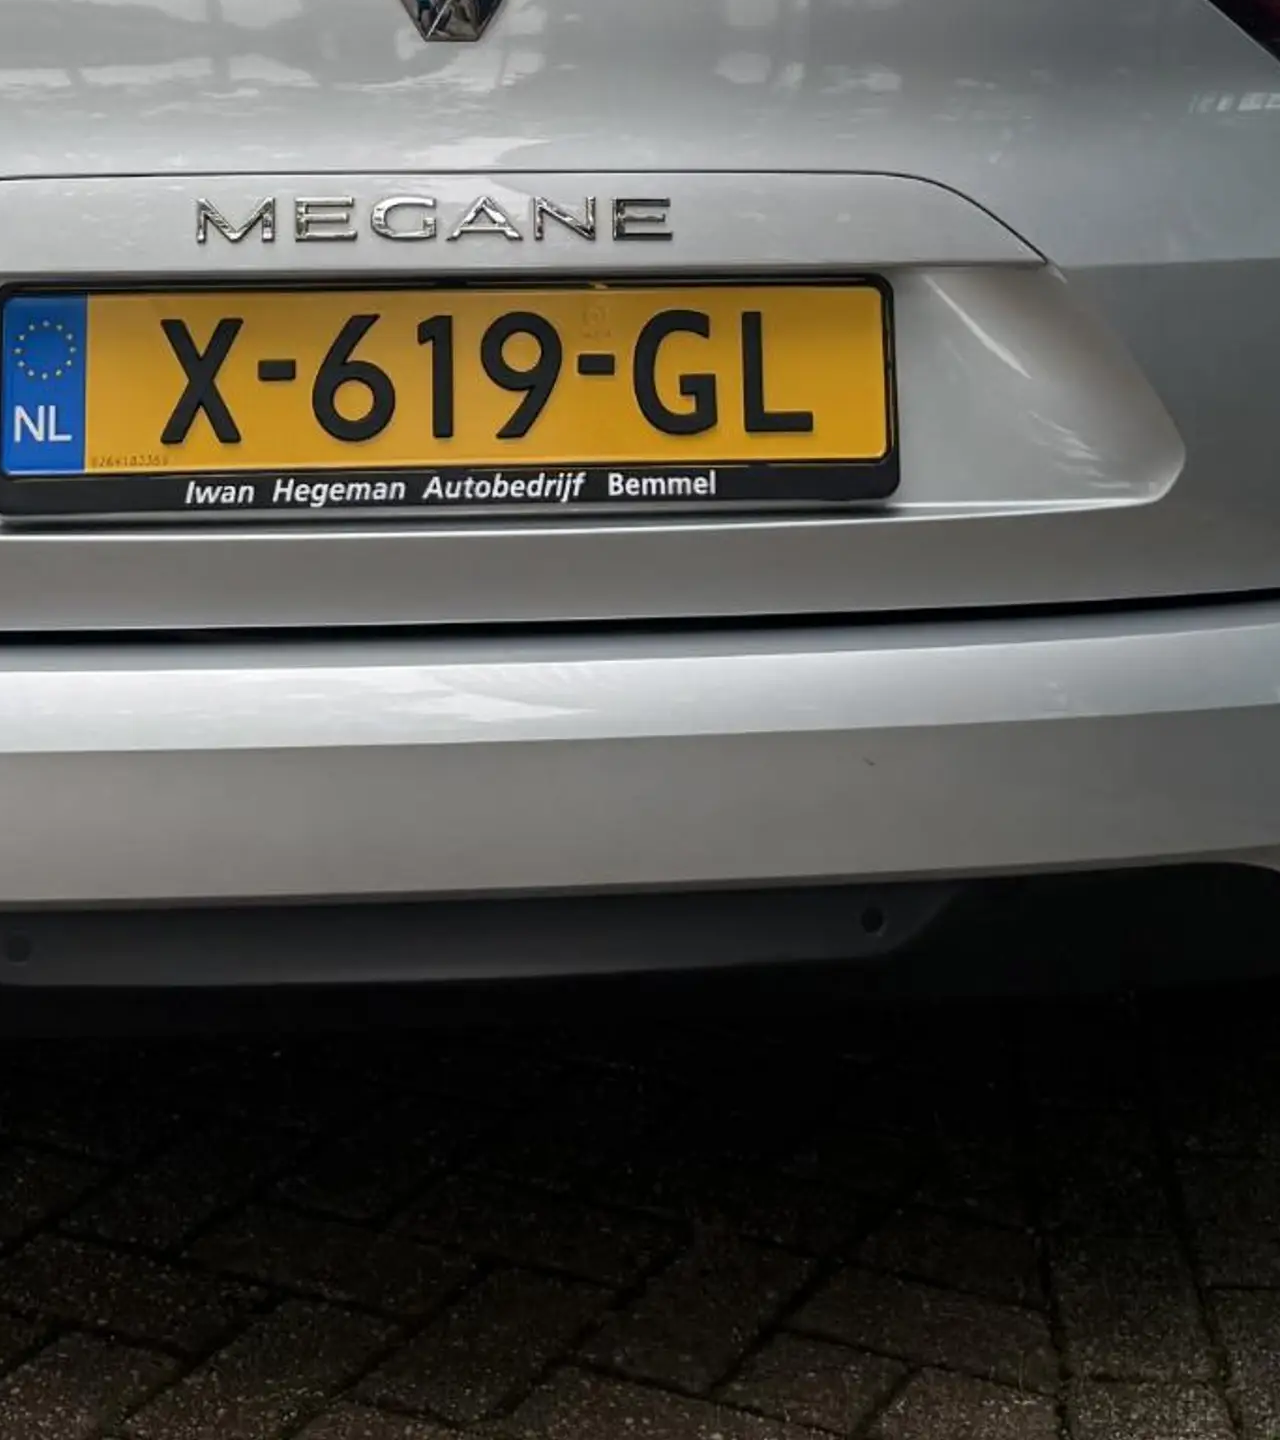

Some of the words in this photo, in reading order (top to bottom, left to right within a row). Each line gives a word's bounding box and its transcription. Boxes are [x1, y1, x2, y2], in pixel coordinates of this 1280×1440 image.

[195, 196, 674, 245] MEGANE
[159, 309, 814, 445] X-619-GL
[13, 404, 73, 444] NL
[184, 479, 256, 505] Iwan
[272, 477, 407, 507] Hegeman
[422, 471, 586, 502] Autobedrijf
[608, 469, 718, 497] Bemmel
